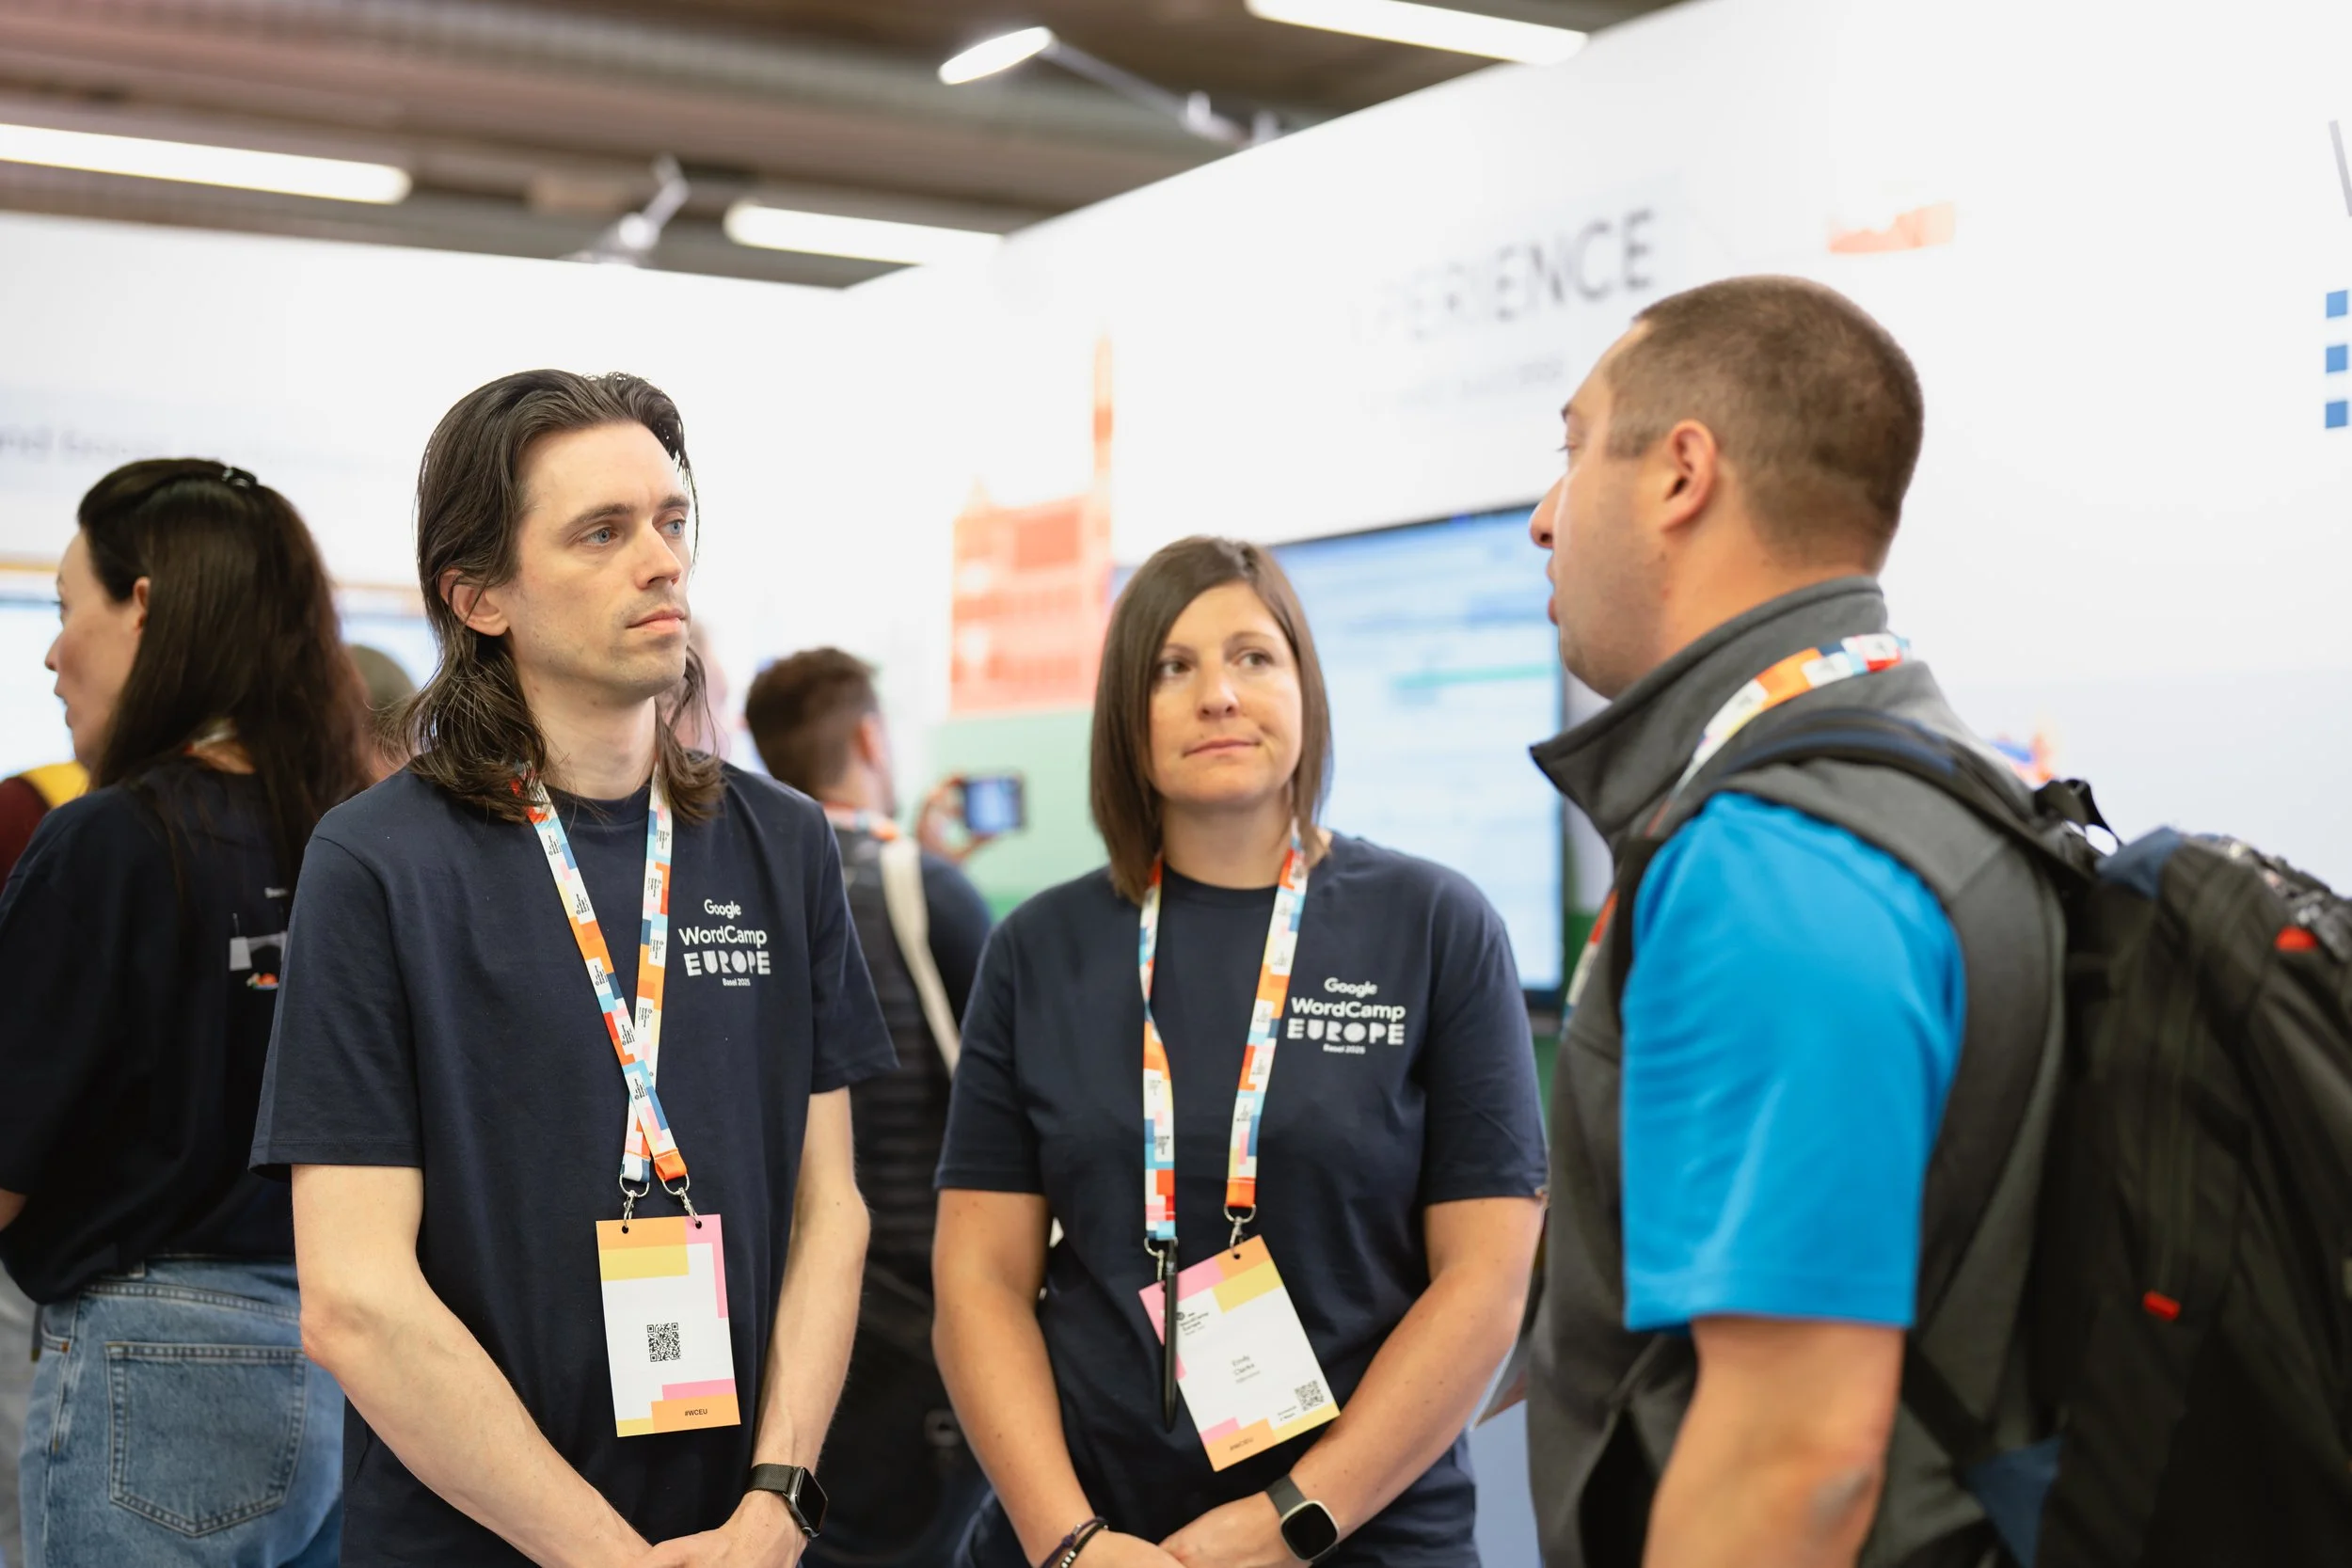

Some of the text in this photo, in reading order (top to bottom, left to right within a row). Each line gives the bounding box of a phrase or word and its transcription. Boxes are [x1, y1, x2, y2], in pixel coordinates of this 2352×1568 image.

[704, 899, 742, 919] Google
[678, 925, 767, 949] WordCamp
[683, 950, 771, 976] EUROPE
[1324, 977, 1378, 998] Google
[1291, 997, 1406, 1022] WordCamp
[1287, 1018, 1405, 1045] EUROPE
[684, 1408, 708, 1417] #WCEU
